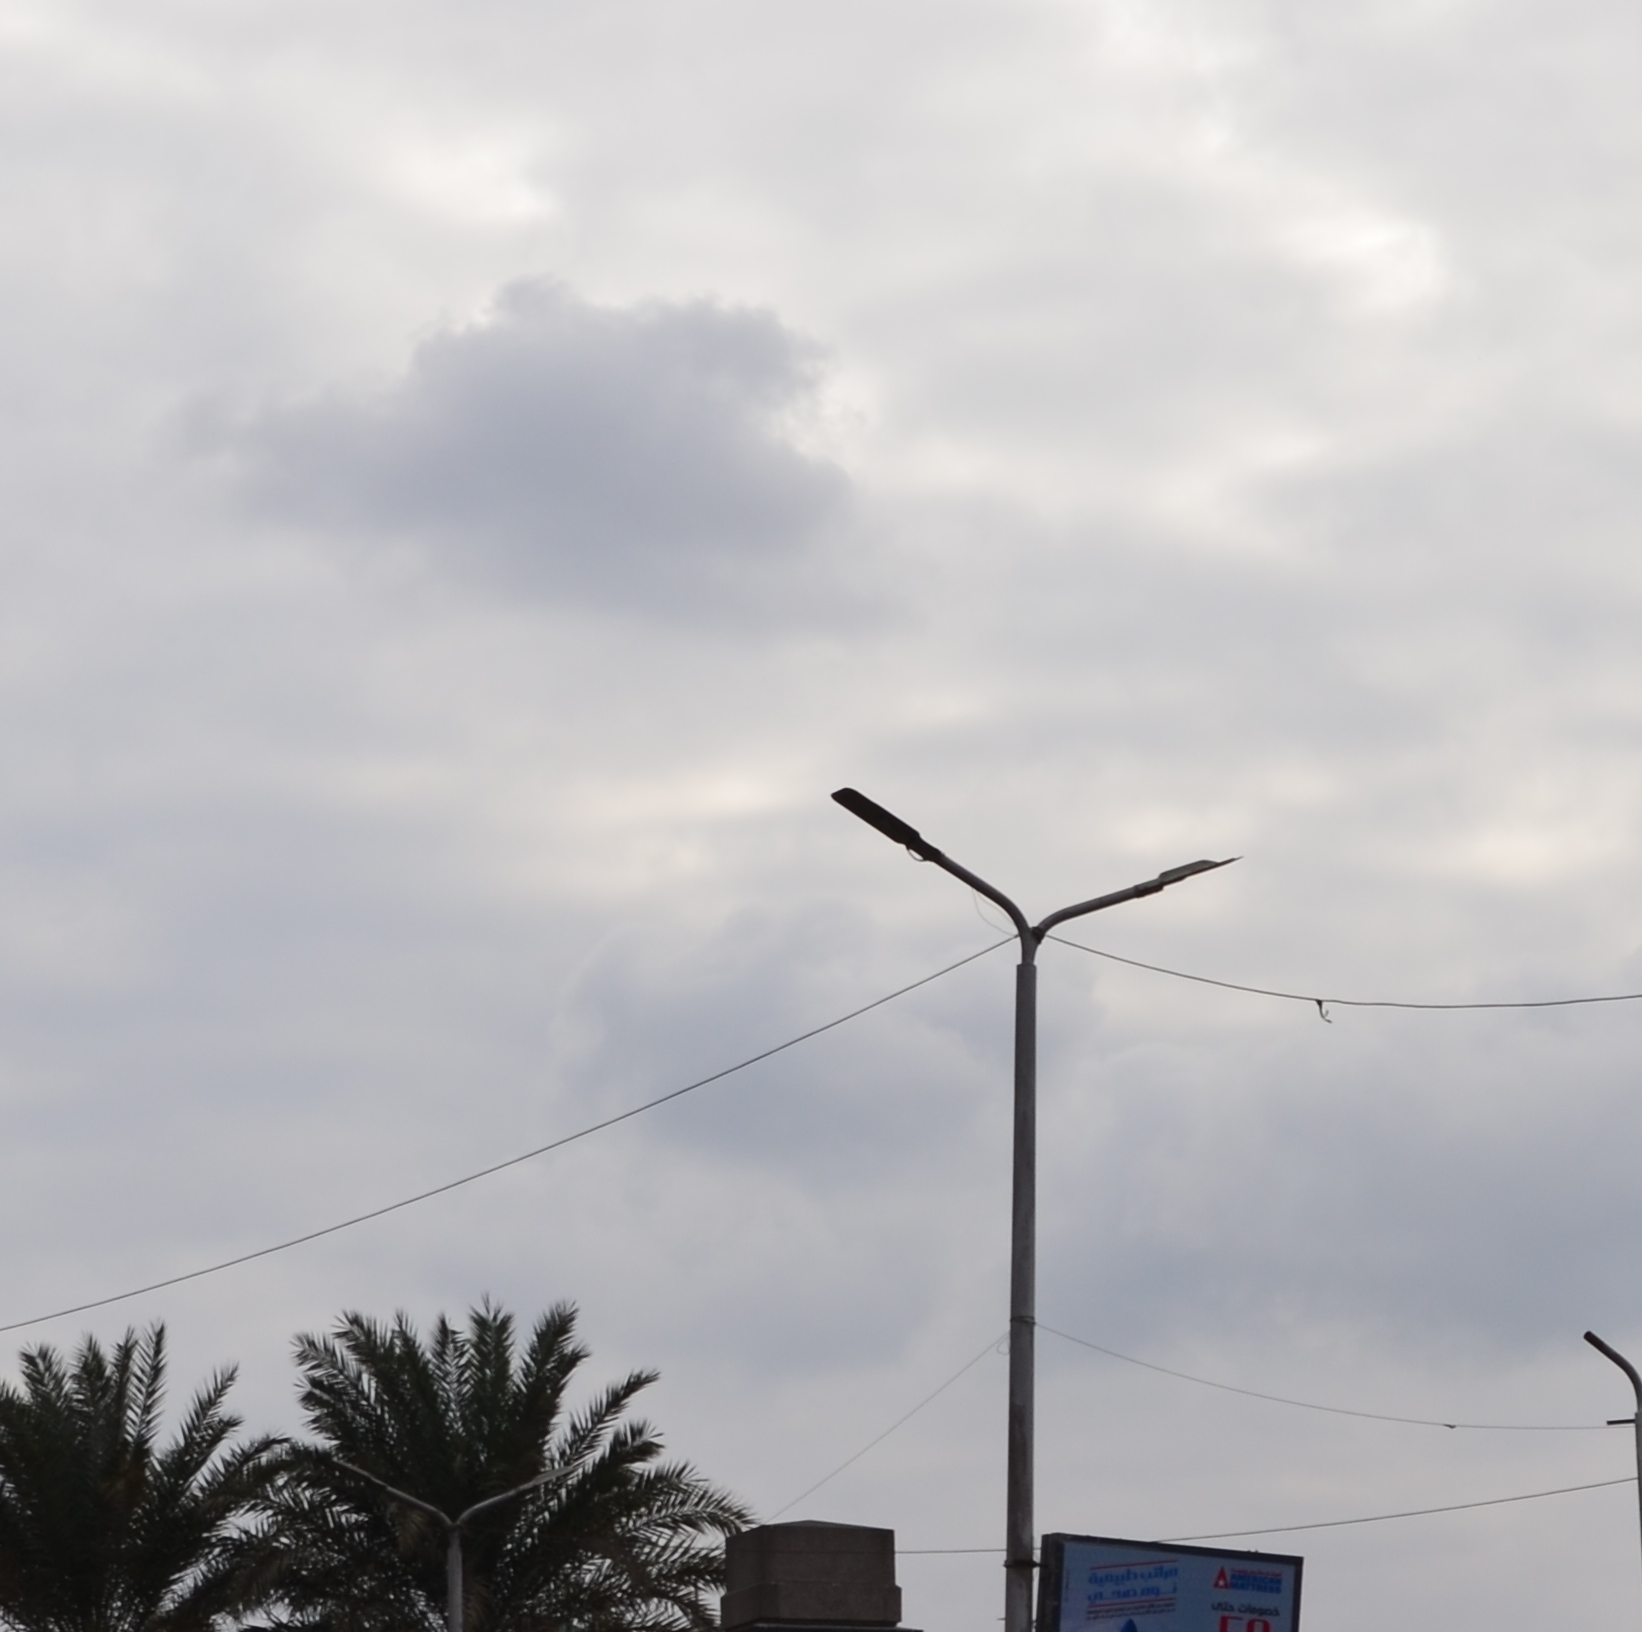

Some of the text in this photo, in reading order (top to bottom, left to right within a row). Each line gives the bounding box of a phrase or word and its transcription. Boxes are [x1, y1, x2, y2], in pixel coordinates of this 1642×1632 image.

[1141, 1565, 1178, 1582] مراتب
[1231, 1573, 1282, 1585] AMERICAN
[1230, 1582, 1281, 1594] MATTRESS
[1211, 1601, 1280, 1617] خصومات حتى
